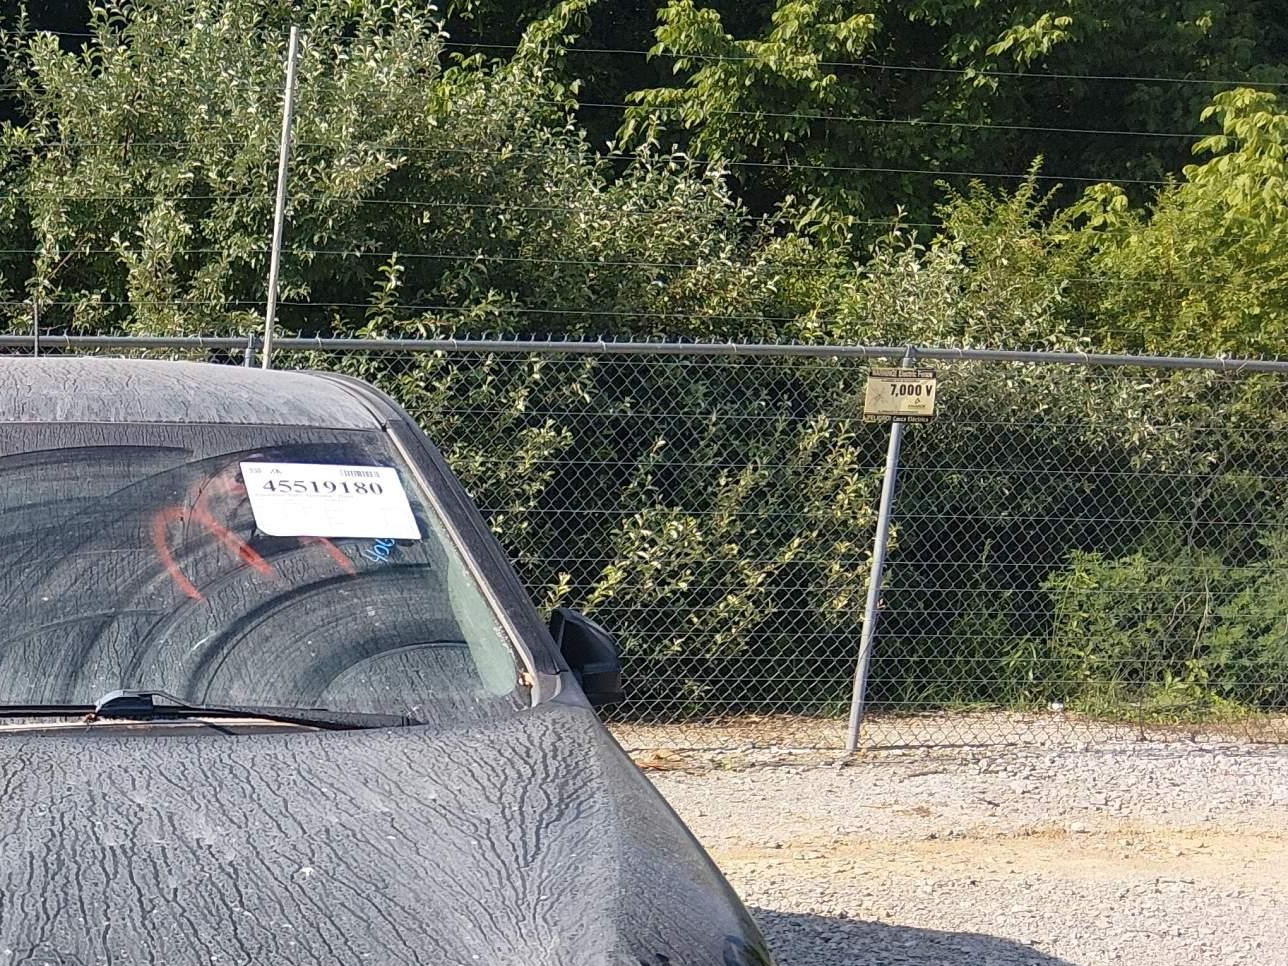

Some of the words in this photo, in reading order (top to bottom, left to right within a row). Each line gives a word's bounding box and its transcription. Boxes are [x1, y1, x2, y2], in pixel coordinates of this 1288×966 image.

[890, 384, 922, 397] 7,000
[925, 385, 933, 396] V
[262, 479, 384, 496] 45519180
